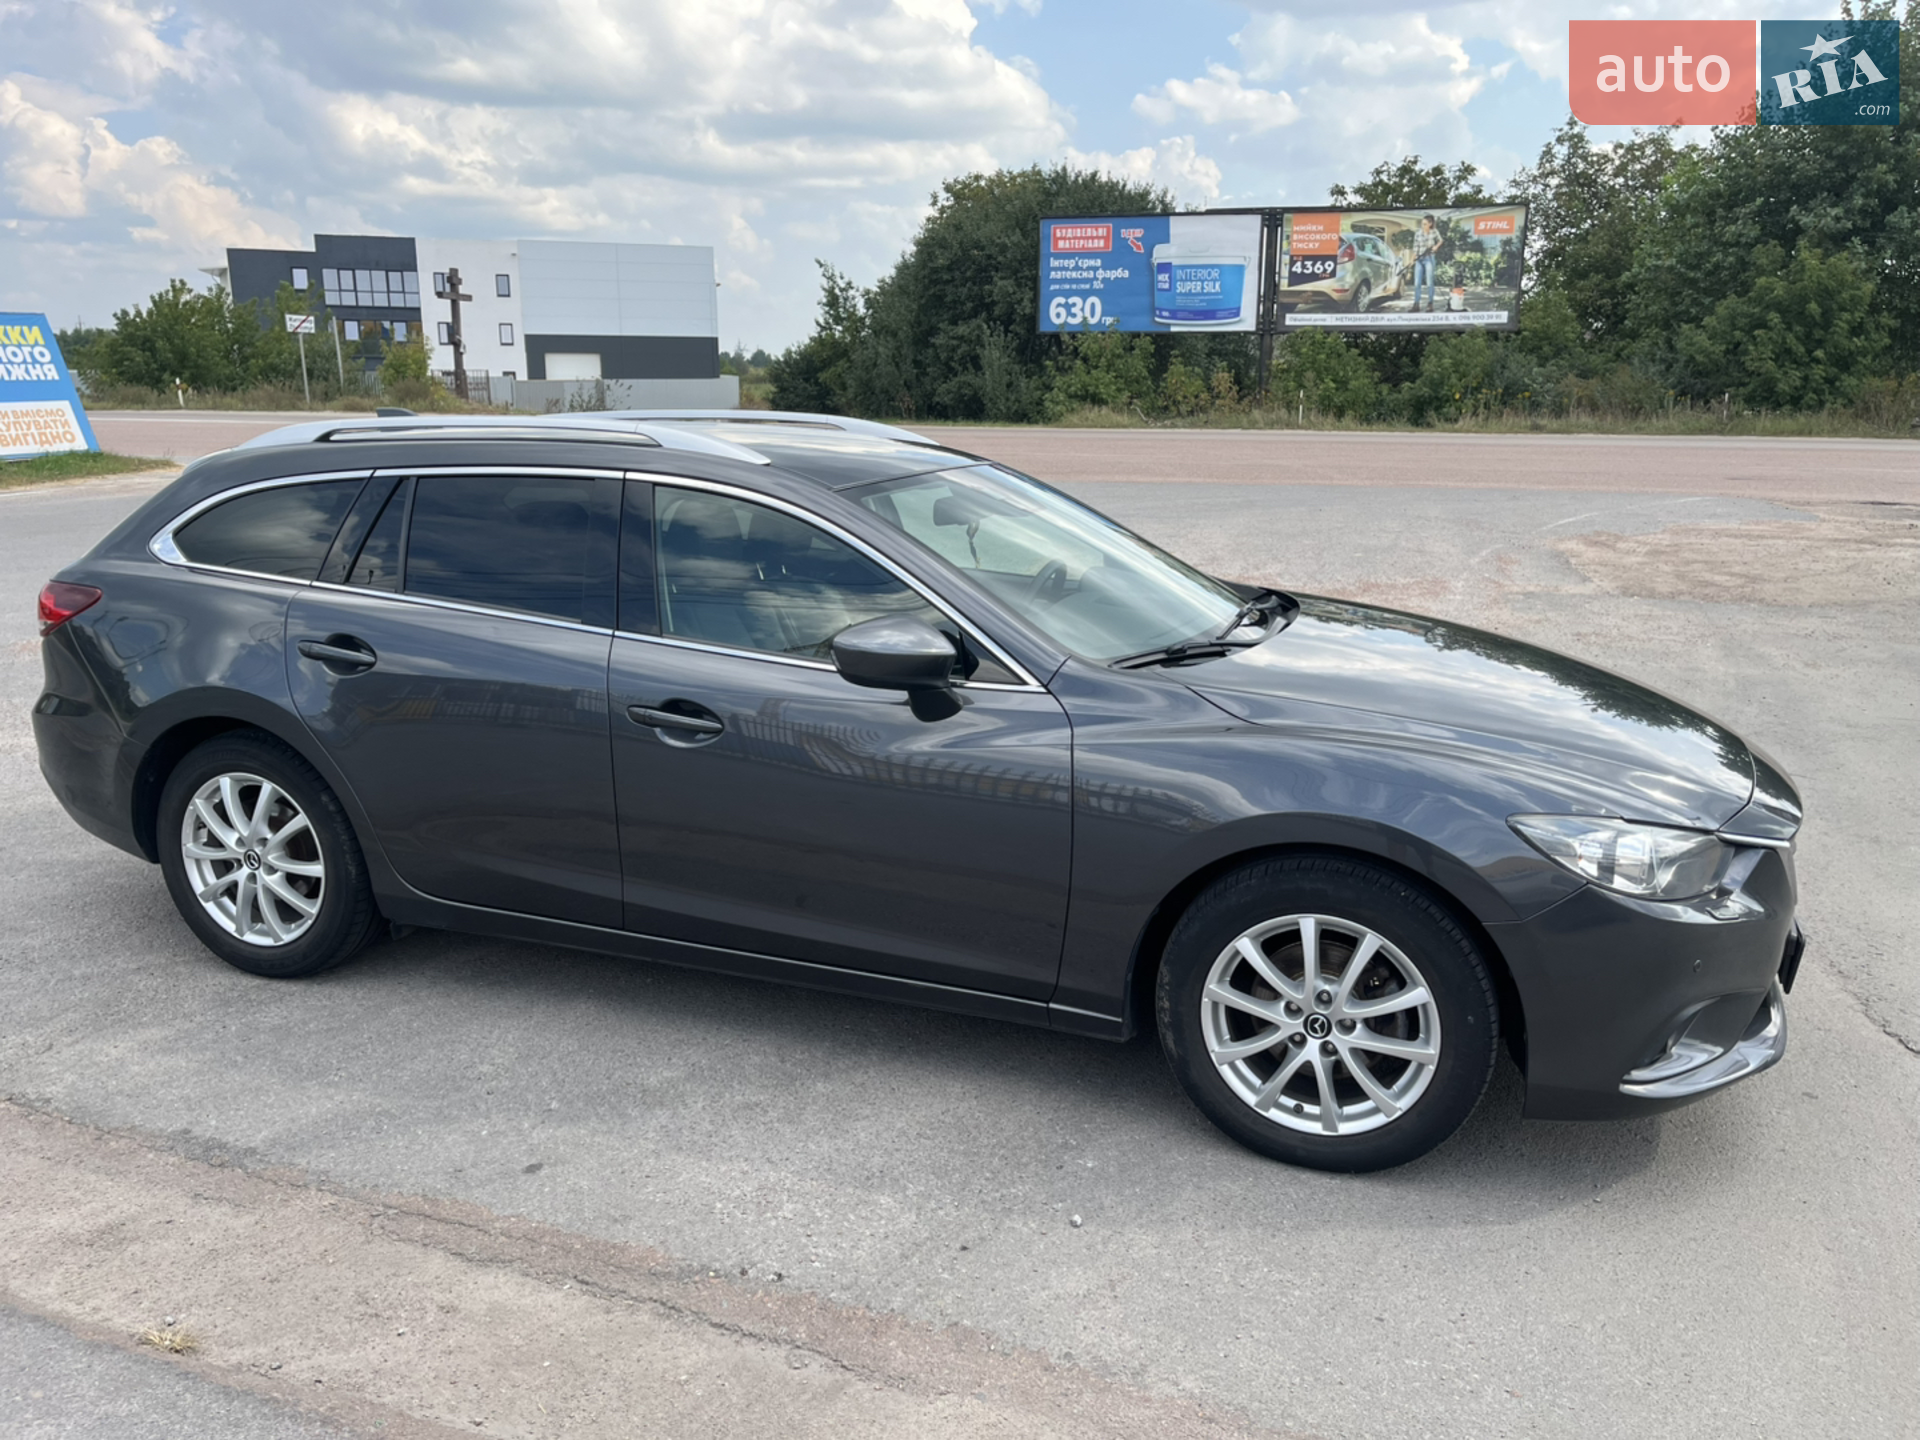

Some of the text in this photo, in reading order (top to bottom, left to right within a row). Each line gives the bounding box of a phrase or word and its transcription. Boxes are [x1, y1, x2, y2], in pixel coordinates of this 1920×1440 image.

[1293, 222, 1323, 231] МИЙКИ
[1477, 220, 1510, 230] STIHL
[1055, 227, 1107, 238] БУДІВЕЛЬНІ
[1293, 233, 1338, 241] ВИСОКОГО
[1058, 239, 1105, 249] МАТЕРІАЛИ
[1049, 267, 1129, 280] латексна фарба
[1291, 260, 1335, 275] 4369
[1176, 268, 1220, 281] INTERIOR
[1176, 280, 1221, 293] SUPER SILK
[1049, 295, 1102, 325] 630
[11, 408, 66, 420] ВМІЄМО
[0, 430, 76, 448] ВИГІДНО
